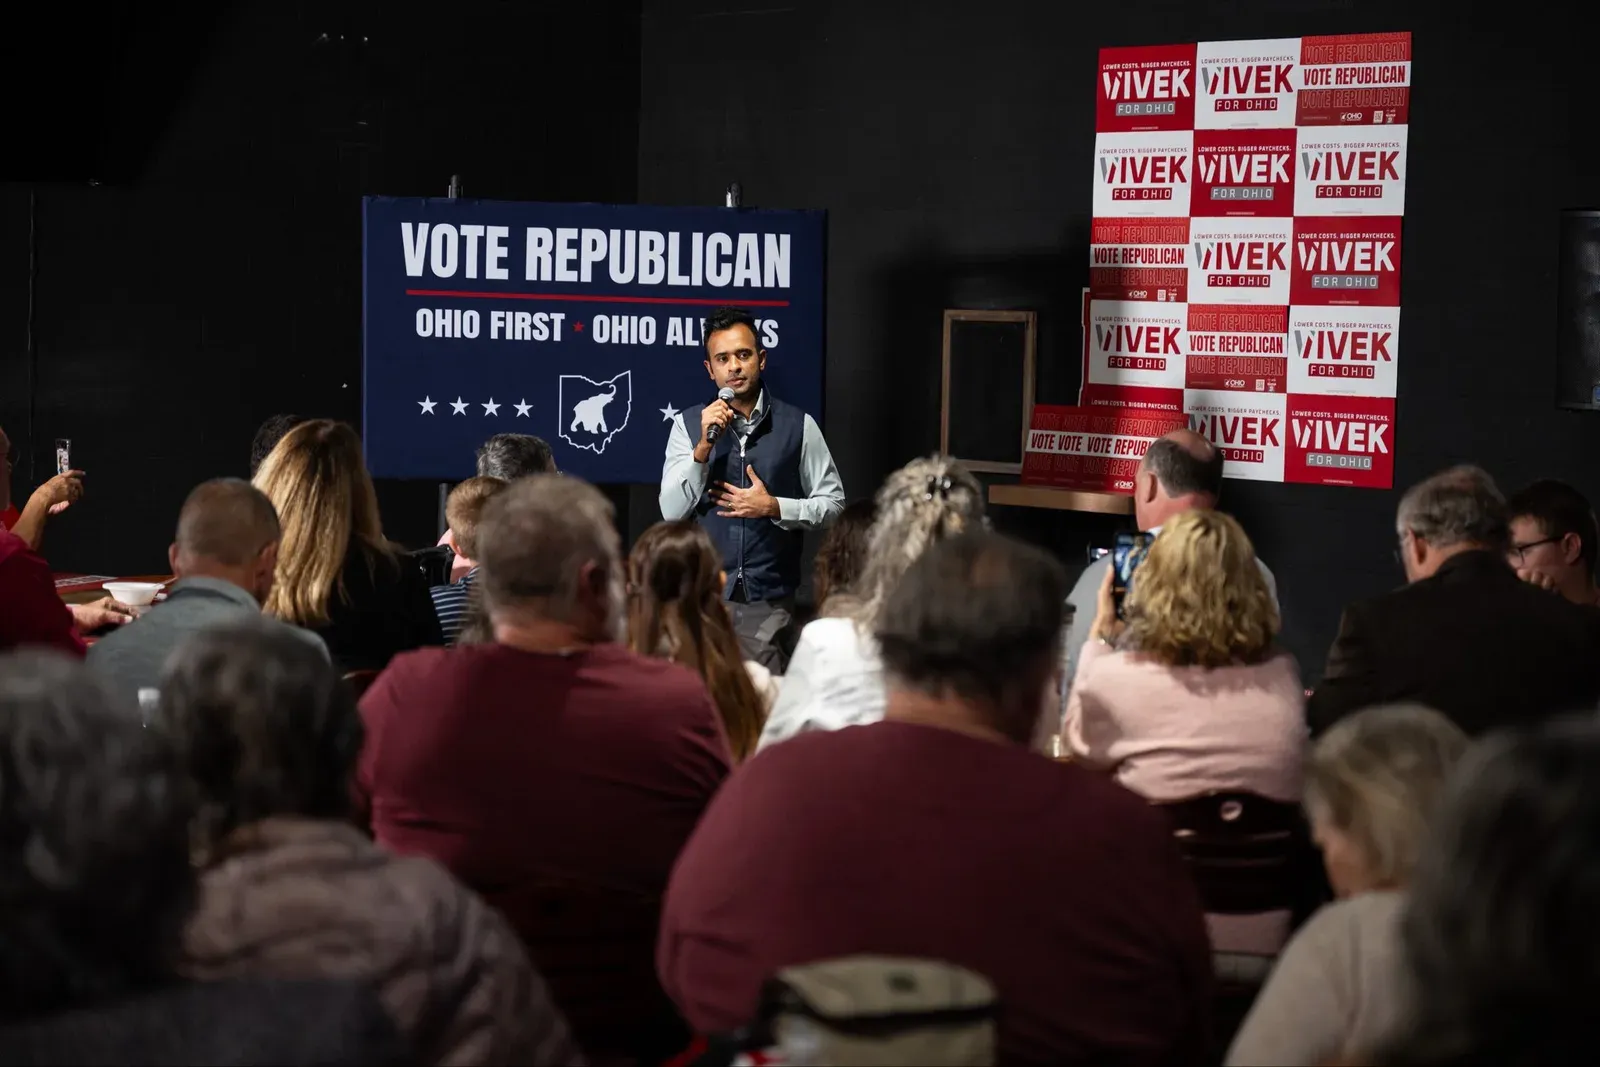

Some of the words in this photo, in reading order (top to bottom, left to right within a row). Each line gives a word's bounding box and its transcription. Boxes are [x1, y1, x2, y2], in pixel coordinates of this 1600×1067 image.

[1305, 45, 1334, 64] VOTE
[1336, 42, 1406, 64] REPUBLICAN
[1103, 69, 1190, 100] VIVEK
[1201, 64, 1294, 94] VIVEK
[1304, 68, 1331, 85] VOTE
[1335, 66, 1405, 84] REPUBLICAN
[1217, 100, 1239, 110] FOR
[1246, 100, 1276, 109] OHIO
[1302, 90, 1331, 109] VOTE
[1333, 88, 1405, 108] REPUBLICAN
[1118, 104, 1140, 114] FOR
[1146, 103, 1174, 113] OHIO
[1100, 156, 1187, 184] VIVEK
[1198, 154, 1290, 183] VIVEK
[1302, 151, 1399, 181] VIVEK
[1114, 190, 1135, 198] FOR
[1142, 189, 1171, 198] OHIO
[1213, 189, 1235, 198] FOR
[1243, 189, 1272, 198] OHIO
[1318, 187, 1342, 196] FOR
[1350, 187, 1381, 196] OHIO
[1095, 226, 1121, 243] VOTE
[1123, 226, 1186, 243] REPUBLICAN
[401, 222, 509, 280] VOTE
[526, 227, 791, 288] REPUBLICAN
[1094, 248, 1118, 264] VOTE
[1122, 248, 1184, 264] REPUBLICAN
[1195, 242, 1286, 270] VIVEK
[1298, 241, 1395, 271] VIVEK
[1122, 269, 1185, 286] REPUBLICAN
[1209, 276, 1232, 285] FOR
[1239, 276, 1269, 286] OHIO
[1314, 277, 1338, 286] FOR
[1346, 278, 1377, 286] OHIO
[416, 308, 480, 338] OHIO
[490, 311, 565, 341] FIRST
[592, 314, 656, 344] OHIO
[666, 317, 779, 348] ALS
[1189, 313, 1216, 330] VOTE
[1220, 314, 1283, 332] REPUBLICAN
[1096, 324, 1181, 354] VIVEK
[1190, 335, 1215, 351] VOTE
[1219, 336, 1283, 353] REPUBLICAN
[1295, 330, 1391, 361] VIVEK
[1109, 359, 1130, 367] FOR
[1137, 359, 1165, 369] OHIO
[1189, 356, 1216, 373] VOTE
[1218, 357, 1284, 376] REPUBLICAN
[1311, 365, 1335, 375] FOR
[1342, 366, 1373, 377] OHIO
[1189, 414, 1279, 447] VIVEK
[1292, 419, 1388, 454] VIVEK
[1031, 433, 1055, 450] VOTE
[1058, 435, 1082, 451] VOTE
[1087, 437, 1112, 453] VOTE
[1114, 439, 1152, 456] REPUB
[1233, 450, 1262, 461] OHIO
[1308, 455, 1332, 465] FOR
[1340, 457, 1371, 468] OHIO
